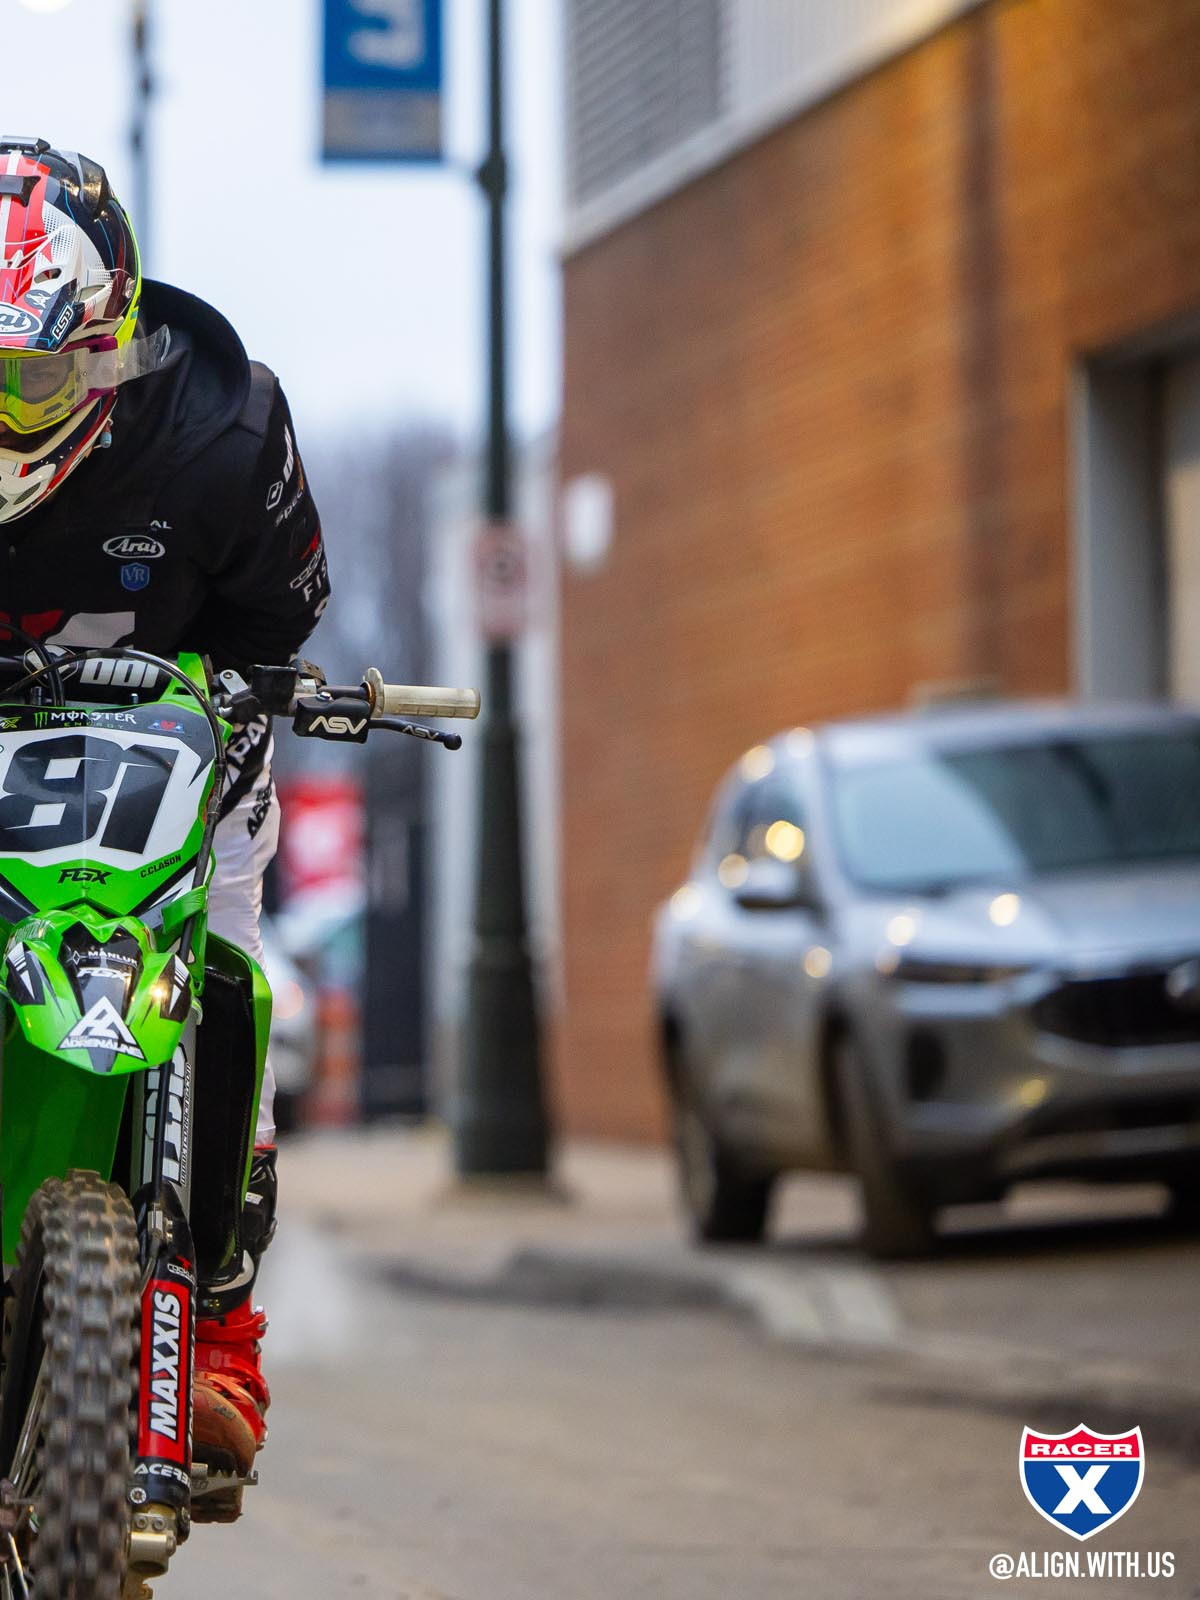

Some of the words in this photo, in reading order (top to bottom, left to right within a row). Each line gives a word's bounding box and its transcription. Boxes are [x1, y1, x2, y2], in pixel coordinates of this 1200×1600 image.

[108, 537, 158, 554] Arai
[308, 715, 368, 734] ASV
[402, 724, 439, 740] ASV
[140, 854, 182, 879] C.CLASON
[150, 1291, 180, 1441] MAXXIS
